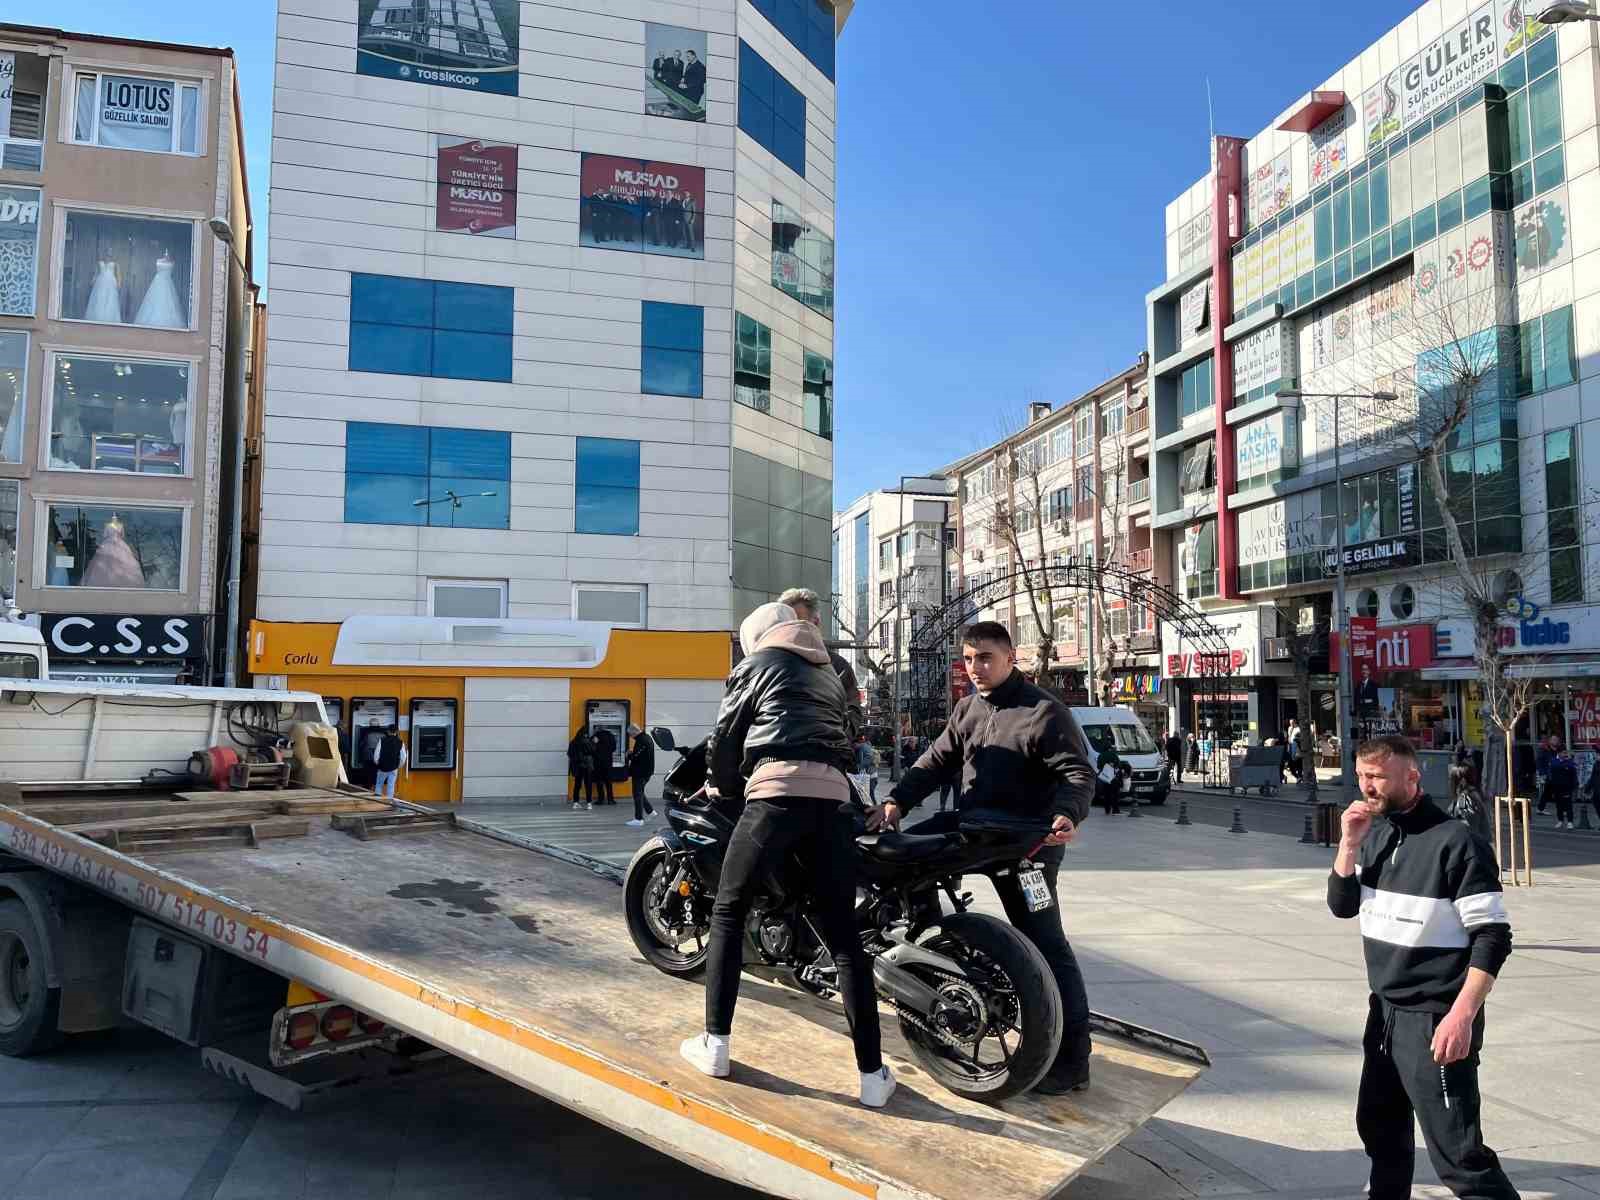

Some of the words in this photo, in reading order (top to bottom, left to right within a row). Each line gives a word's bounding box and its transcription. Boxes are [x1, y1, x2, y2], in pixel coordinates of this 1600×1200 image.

[1404, 13, 1493, 92] GÜLER
[1455, 41, 1496, 78] KURSU
[106, 81, 171, 113] LOTUS
[104, 110, 139, 123] GÜZELLİK
[140, 113, 169, 127] SALONU
[1234, 325, 1277, 353] AVUKAT
[1239, 438, 1279, 463] HASAR
[1254, 519, 1301, 542] AVUKAT
[1326, 550, 1353, 567] NUE
[1353, 540, 1406, 562] GELİNLİK
[284, 652, 319, 666] Çorlu
[174, 896, 208, 930] 514
[213, 912, 238, 945] 03
[243, 926, 271, 961] 54
